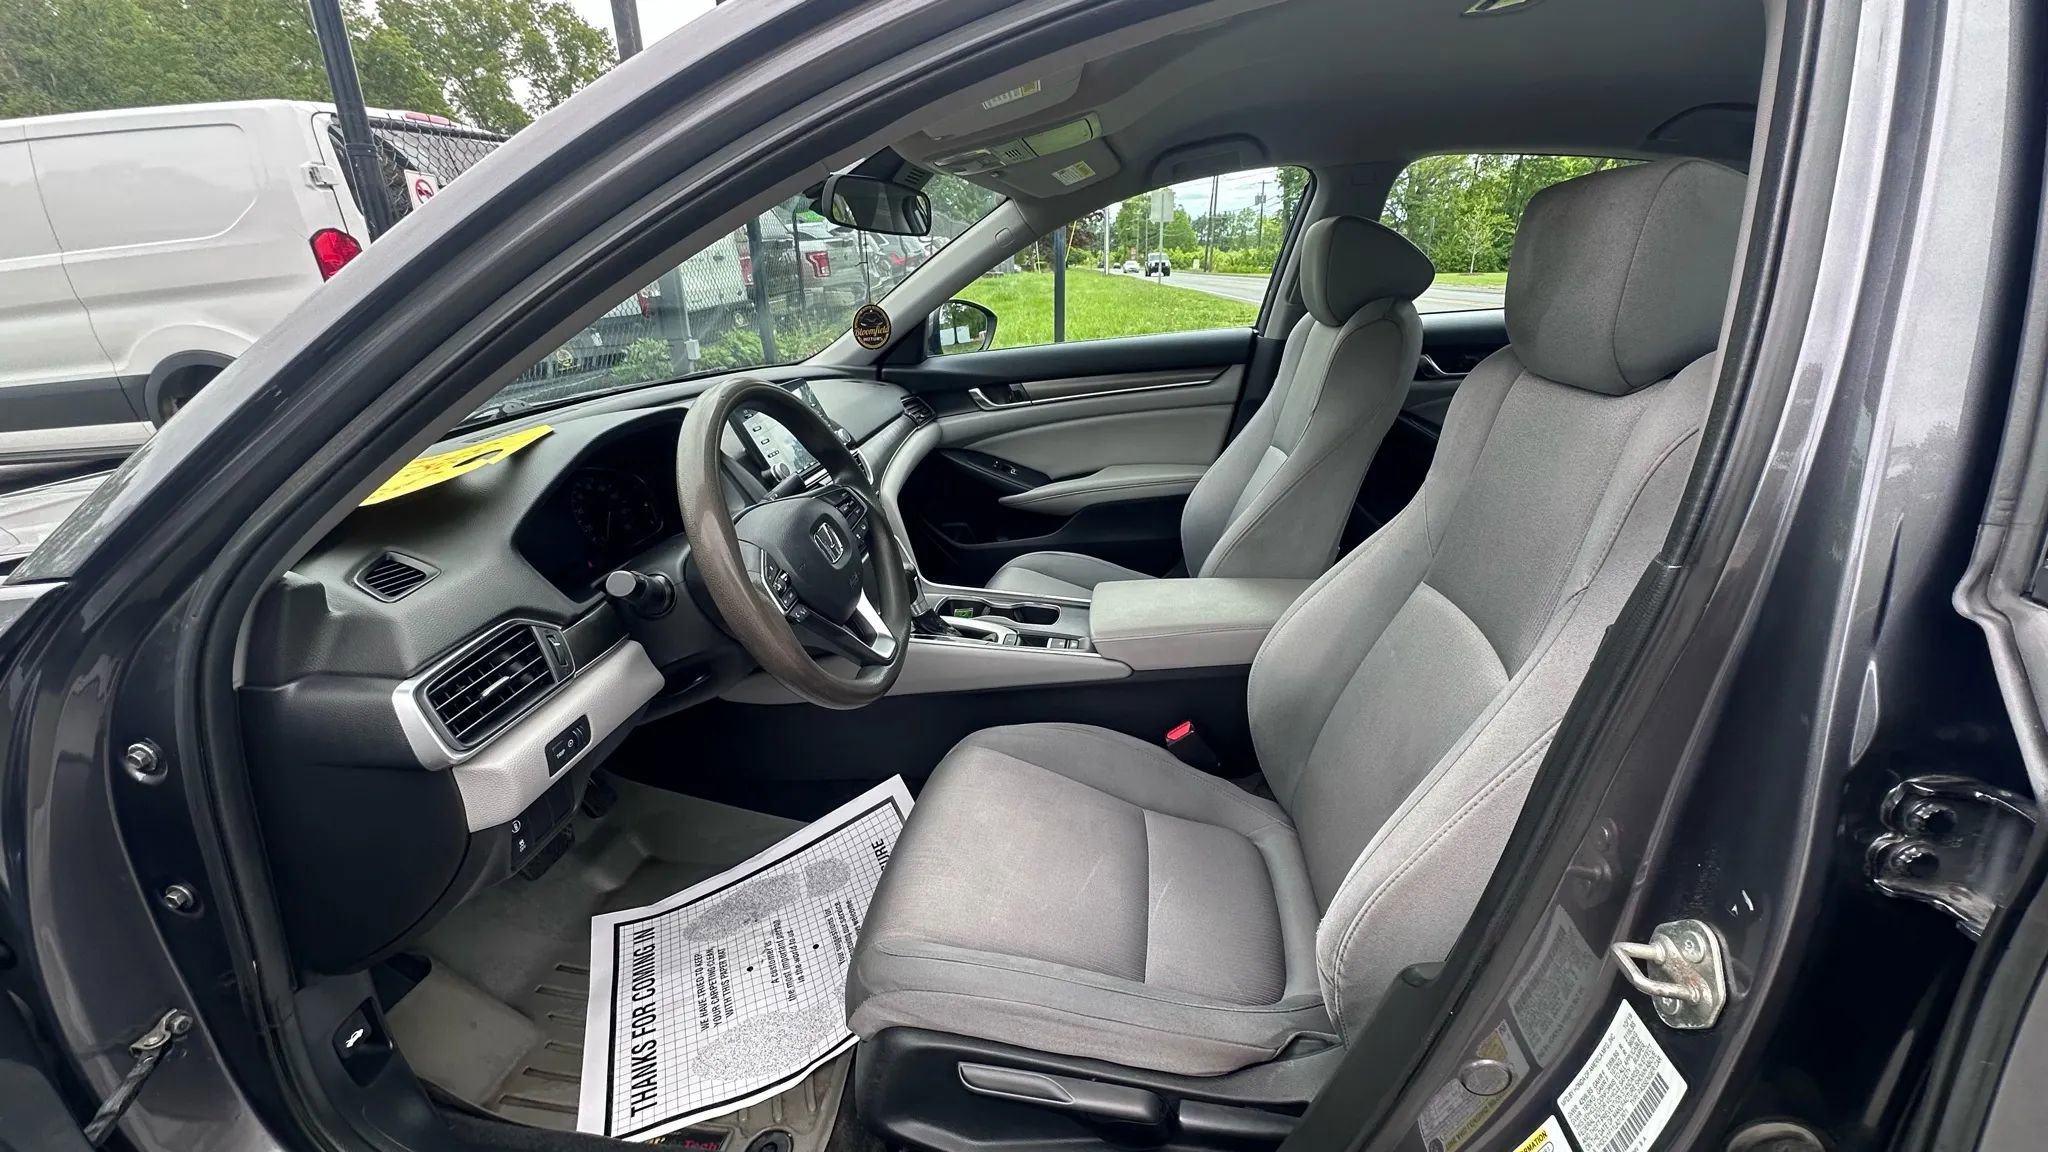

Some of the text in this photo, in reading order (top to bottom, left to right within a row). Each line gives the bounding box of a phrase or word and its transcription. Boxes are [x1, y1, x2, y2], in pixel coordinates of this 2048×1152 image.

[824, 908, 832, 917] for
[834, 901, 846, 923] service
[633, 927, 655, 944] IN
[827, 917, 842, 952] suggestions
[767, 948, 778, 977] customer
[773, 920, 797, 1001] the most important person
[790, 945, 800, 963] world
[795, 964, 803, 975] the
[632, 943, 655, 1002] COMING
[707, 967, 719, 1005] CARPETING
[718, 948, 734, 1019] WITH THIS PAPER MAT
[694, 954, 709, 1032] WE HAVE TRIED TO KEEP
[632, 1002, 656, 1039] FOR
[712, 1005, 722, 1028] YOUR
[631, 1039, 657, 1118] THANKS
